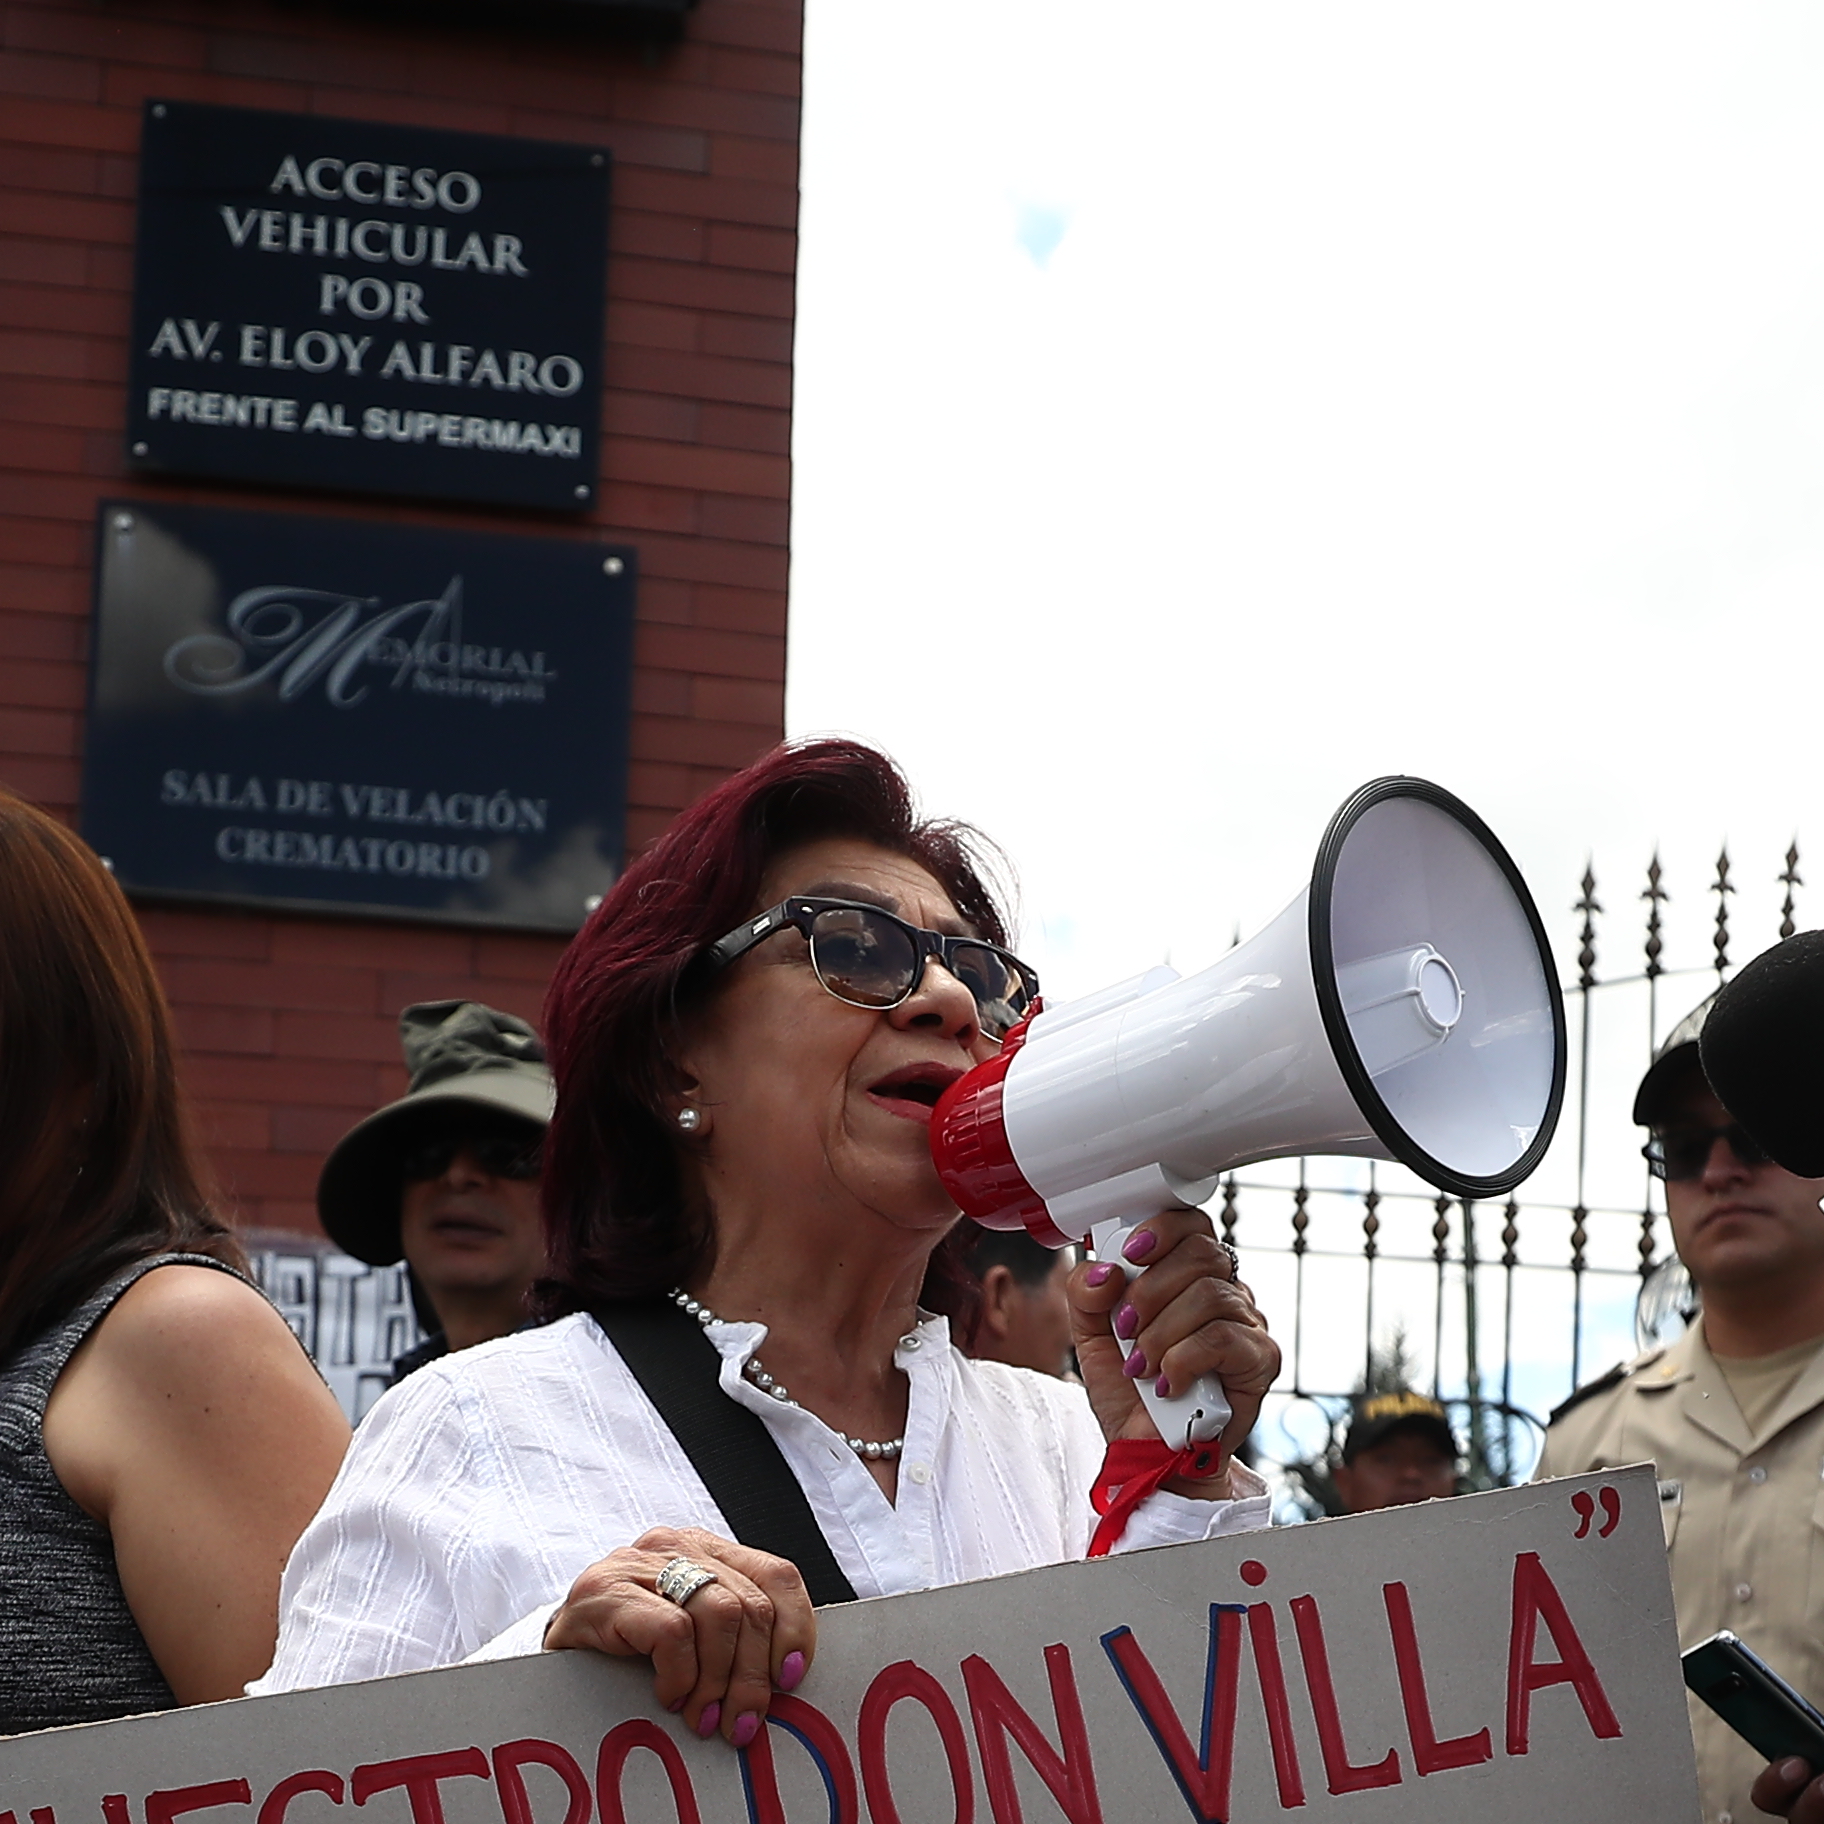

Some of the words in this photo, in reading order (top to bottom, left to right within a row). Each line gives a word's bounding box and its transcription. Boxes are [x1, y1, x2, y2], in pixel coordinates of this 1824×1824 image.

[270, 154, 482, 215] ACCESO
[219, 204, 531, 278] VEHICULAR
[319, 272, 431, 325] POR
[149, 317, 223, 363] AV.
[238, 323, 373, 377] ELOY
[380, 339, 584, 398] ALFARO
[147, 386, 300, 432] FRENTE
[303, 401, 357, 438] AL
[362, 406, 583, 459] SUPERMAXI
[160, 768, 268, 813] SALA
[276, 777, 334, 816] DE
[339, 783, 549, 835] VELACIÓN
[214, 825, 491, 882] CREMATORIO
